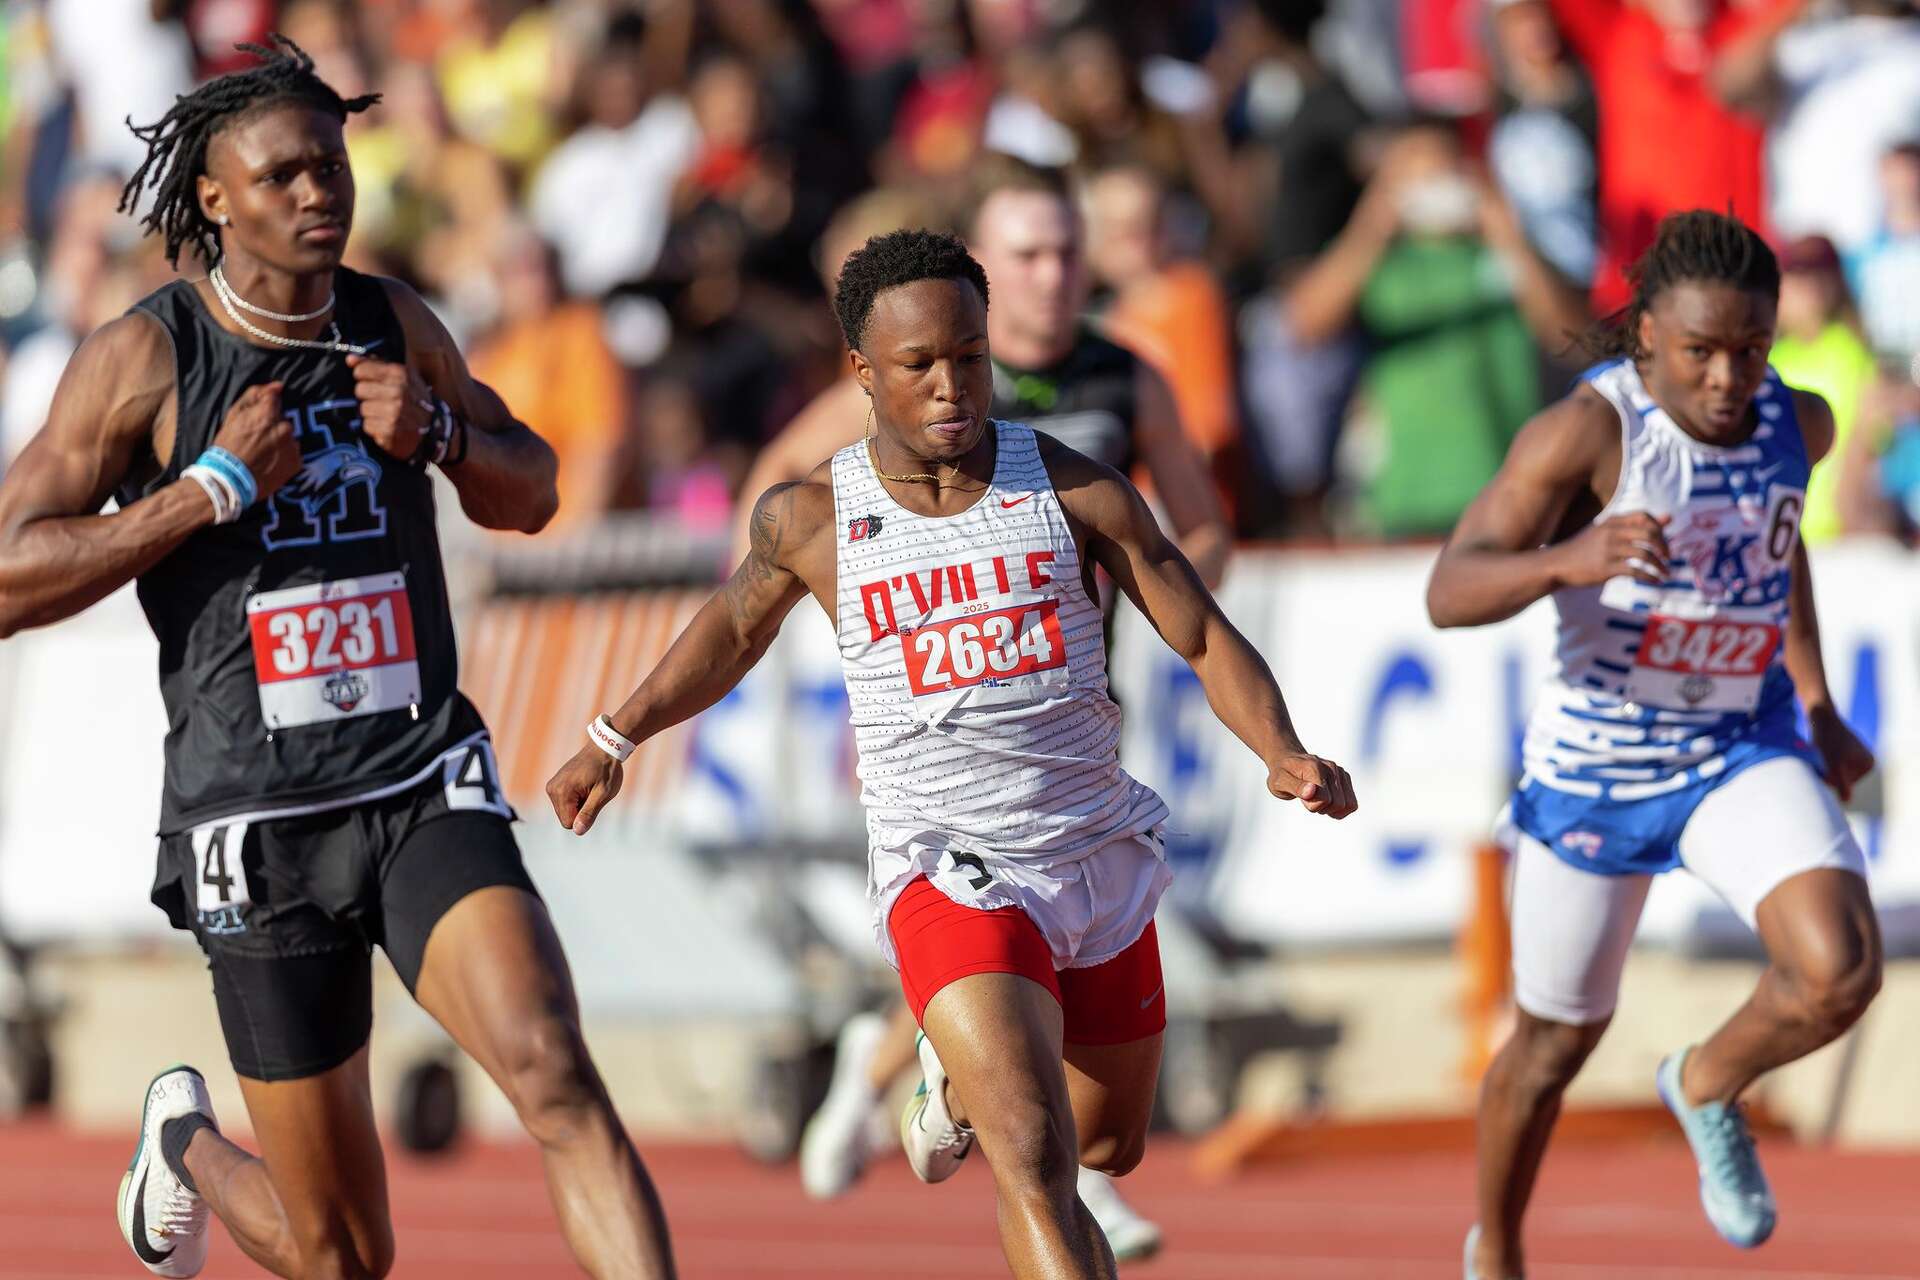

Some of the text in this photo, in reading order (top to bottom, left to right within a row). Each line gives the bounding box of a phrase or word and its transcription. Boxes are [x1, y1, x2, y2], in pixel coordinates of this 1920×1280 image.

[848, 518, 869, 544] D
[1703, 533, 1759, 579] K
[1767, 495, 1800, 561] 6
[269, 598, 399, 674] 3231
[963, 602, 990, 614] 2025
[915, 610, 1053, 687] 2634
[1649, 618, 1767, 671] 3422
[455, 744, 495, 804] 4
[203, 825, 234, 902] 4
